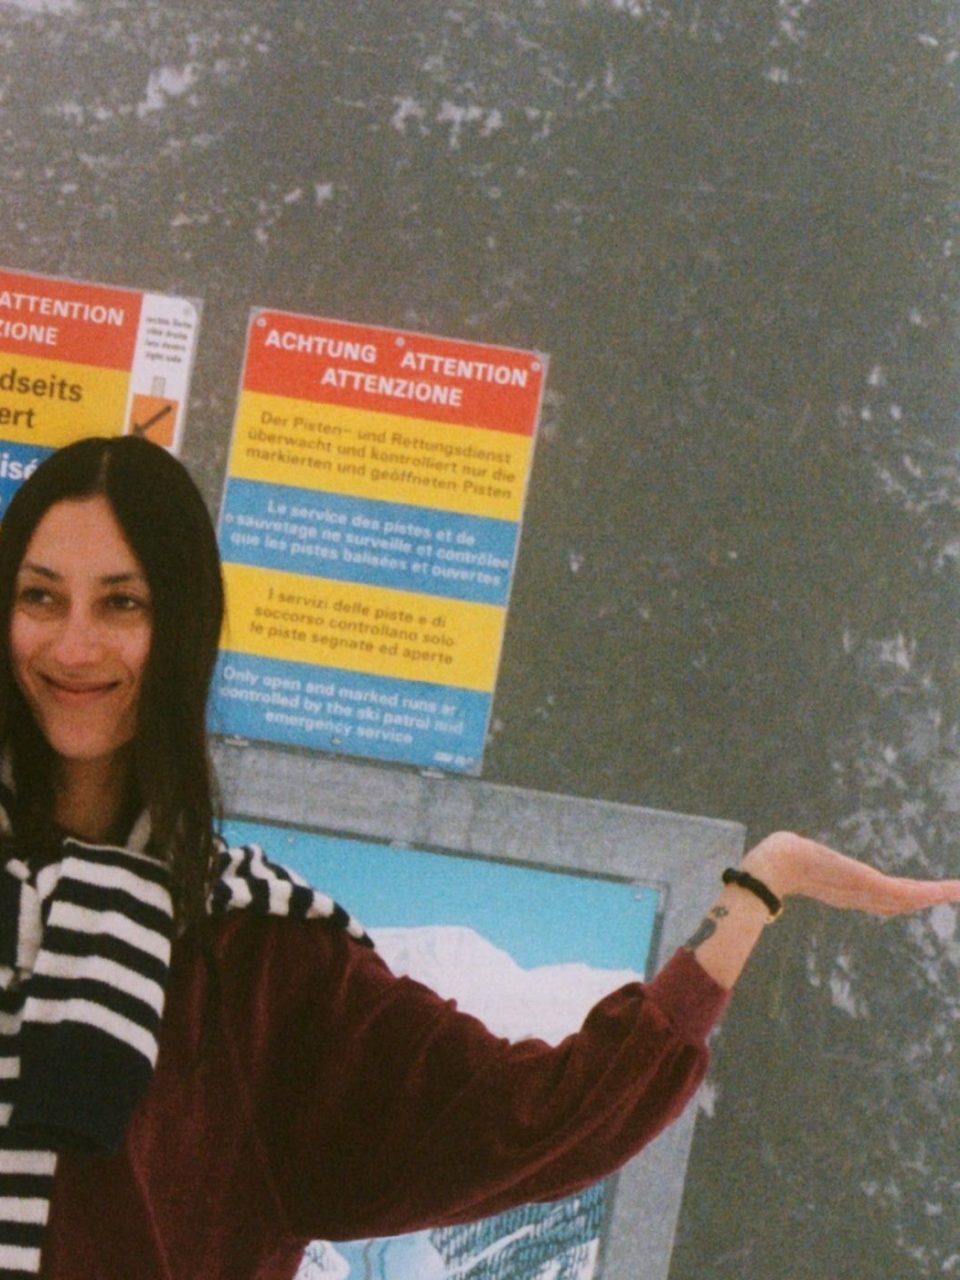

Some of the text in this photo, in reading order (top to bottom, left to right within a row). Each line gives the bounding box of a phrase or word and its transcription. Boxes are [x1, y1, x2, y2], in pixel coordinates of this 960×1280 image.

[264, 329, 527, 387] ACHTUNG ATTENTION
[321, 367, 462, 406] ATTENZIONE
[247, 428, 516, 482] überwacht und kontrolliert nur die
[260, 410, 511, 464] Der Pisten- und Rettungsdienst
[245, 447, 512, 499] markierten und geöffneten Pisten
[235, 514, 318, 540] sauvetage
[321, 529, 341, 542] ne
[343, 532, 411, 553] surveille
[415, 544, 433, 557] et
[267, 499, 476, 545] Le service des pistes et de
[230, 531, 500, 586] que les pistes balisées et ouvertes
[254, 606, 455, 647] soccorso controllano solo
[267, 586, 445, 627] I servizi delle piste e di
[249, 620, 453, 664] le piste segnate ed aperte
[220, 686, 300, 708] controlled
[302, 697, 321, 714] by
[325, 701, 353, 716] the
[356, 706, 380, 720] ski
[382, 712, 430, 729] patrol
[223, 665, 259, 685] Only
[262, 675, 301, 691] open
[304, 681, 335, 696] and
[337, 687, 398, 707] marked
[402, 698, 438, 713] runs
[264, 710, 413, 744] emergency service
